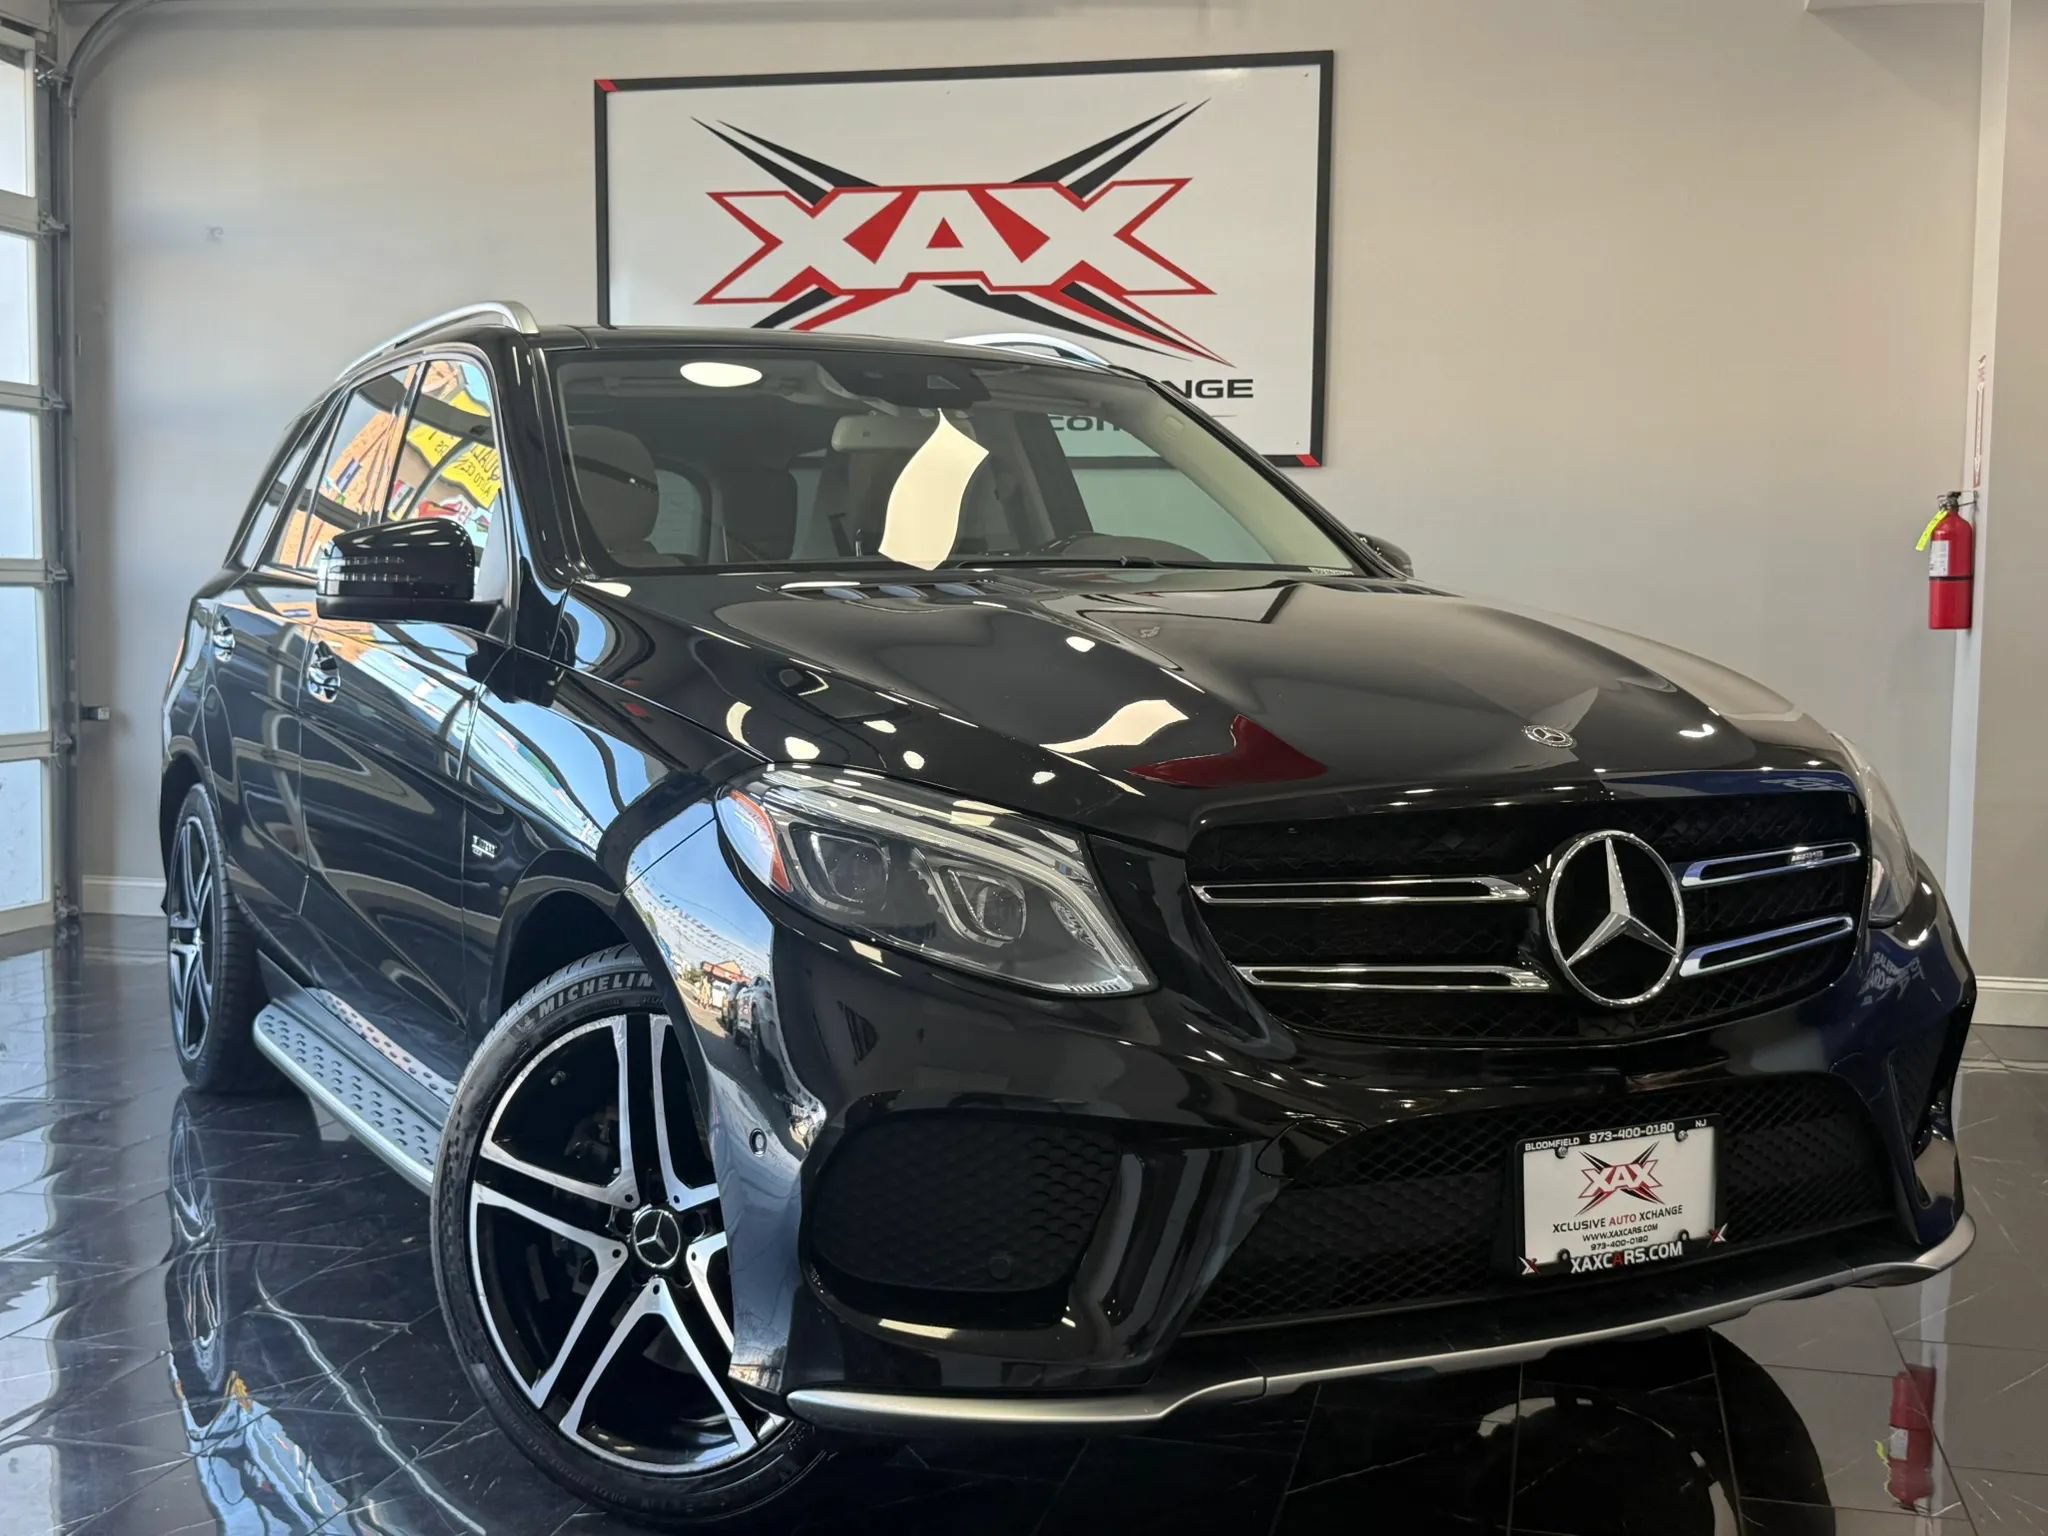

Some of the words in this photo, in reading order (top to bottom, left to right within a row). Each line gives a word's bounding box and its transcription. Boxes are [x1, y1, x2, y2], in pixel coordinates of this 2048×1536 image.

[695, 178, 1216, 304] XAX
[538, 971, 653, 1018] MICHELIN
[1524, 1136, 1580, 1151] BLOOMFIELD
[1589, 1121, 1675, 1143] 973-400-0180
[1695, 1118, 1707, 1128] NJ
[1578, 1159, 1663, 1199] XAX
[1552, 1216, 1606, 1234] XCLUSIVE
[1608, 1212, 1637, 1226] AUTO
[1639, 1204, 1683, 1222] XCHANGE
[1582, 1223, 1659, 1243] WWW.XAXCARS.COM
[1570, 1241, 1684, 1274] XAXCARS.COM
[1590, 1235, 1649, 1251] 973-400-0180
